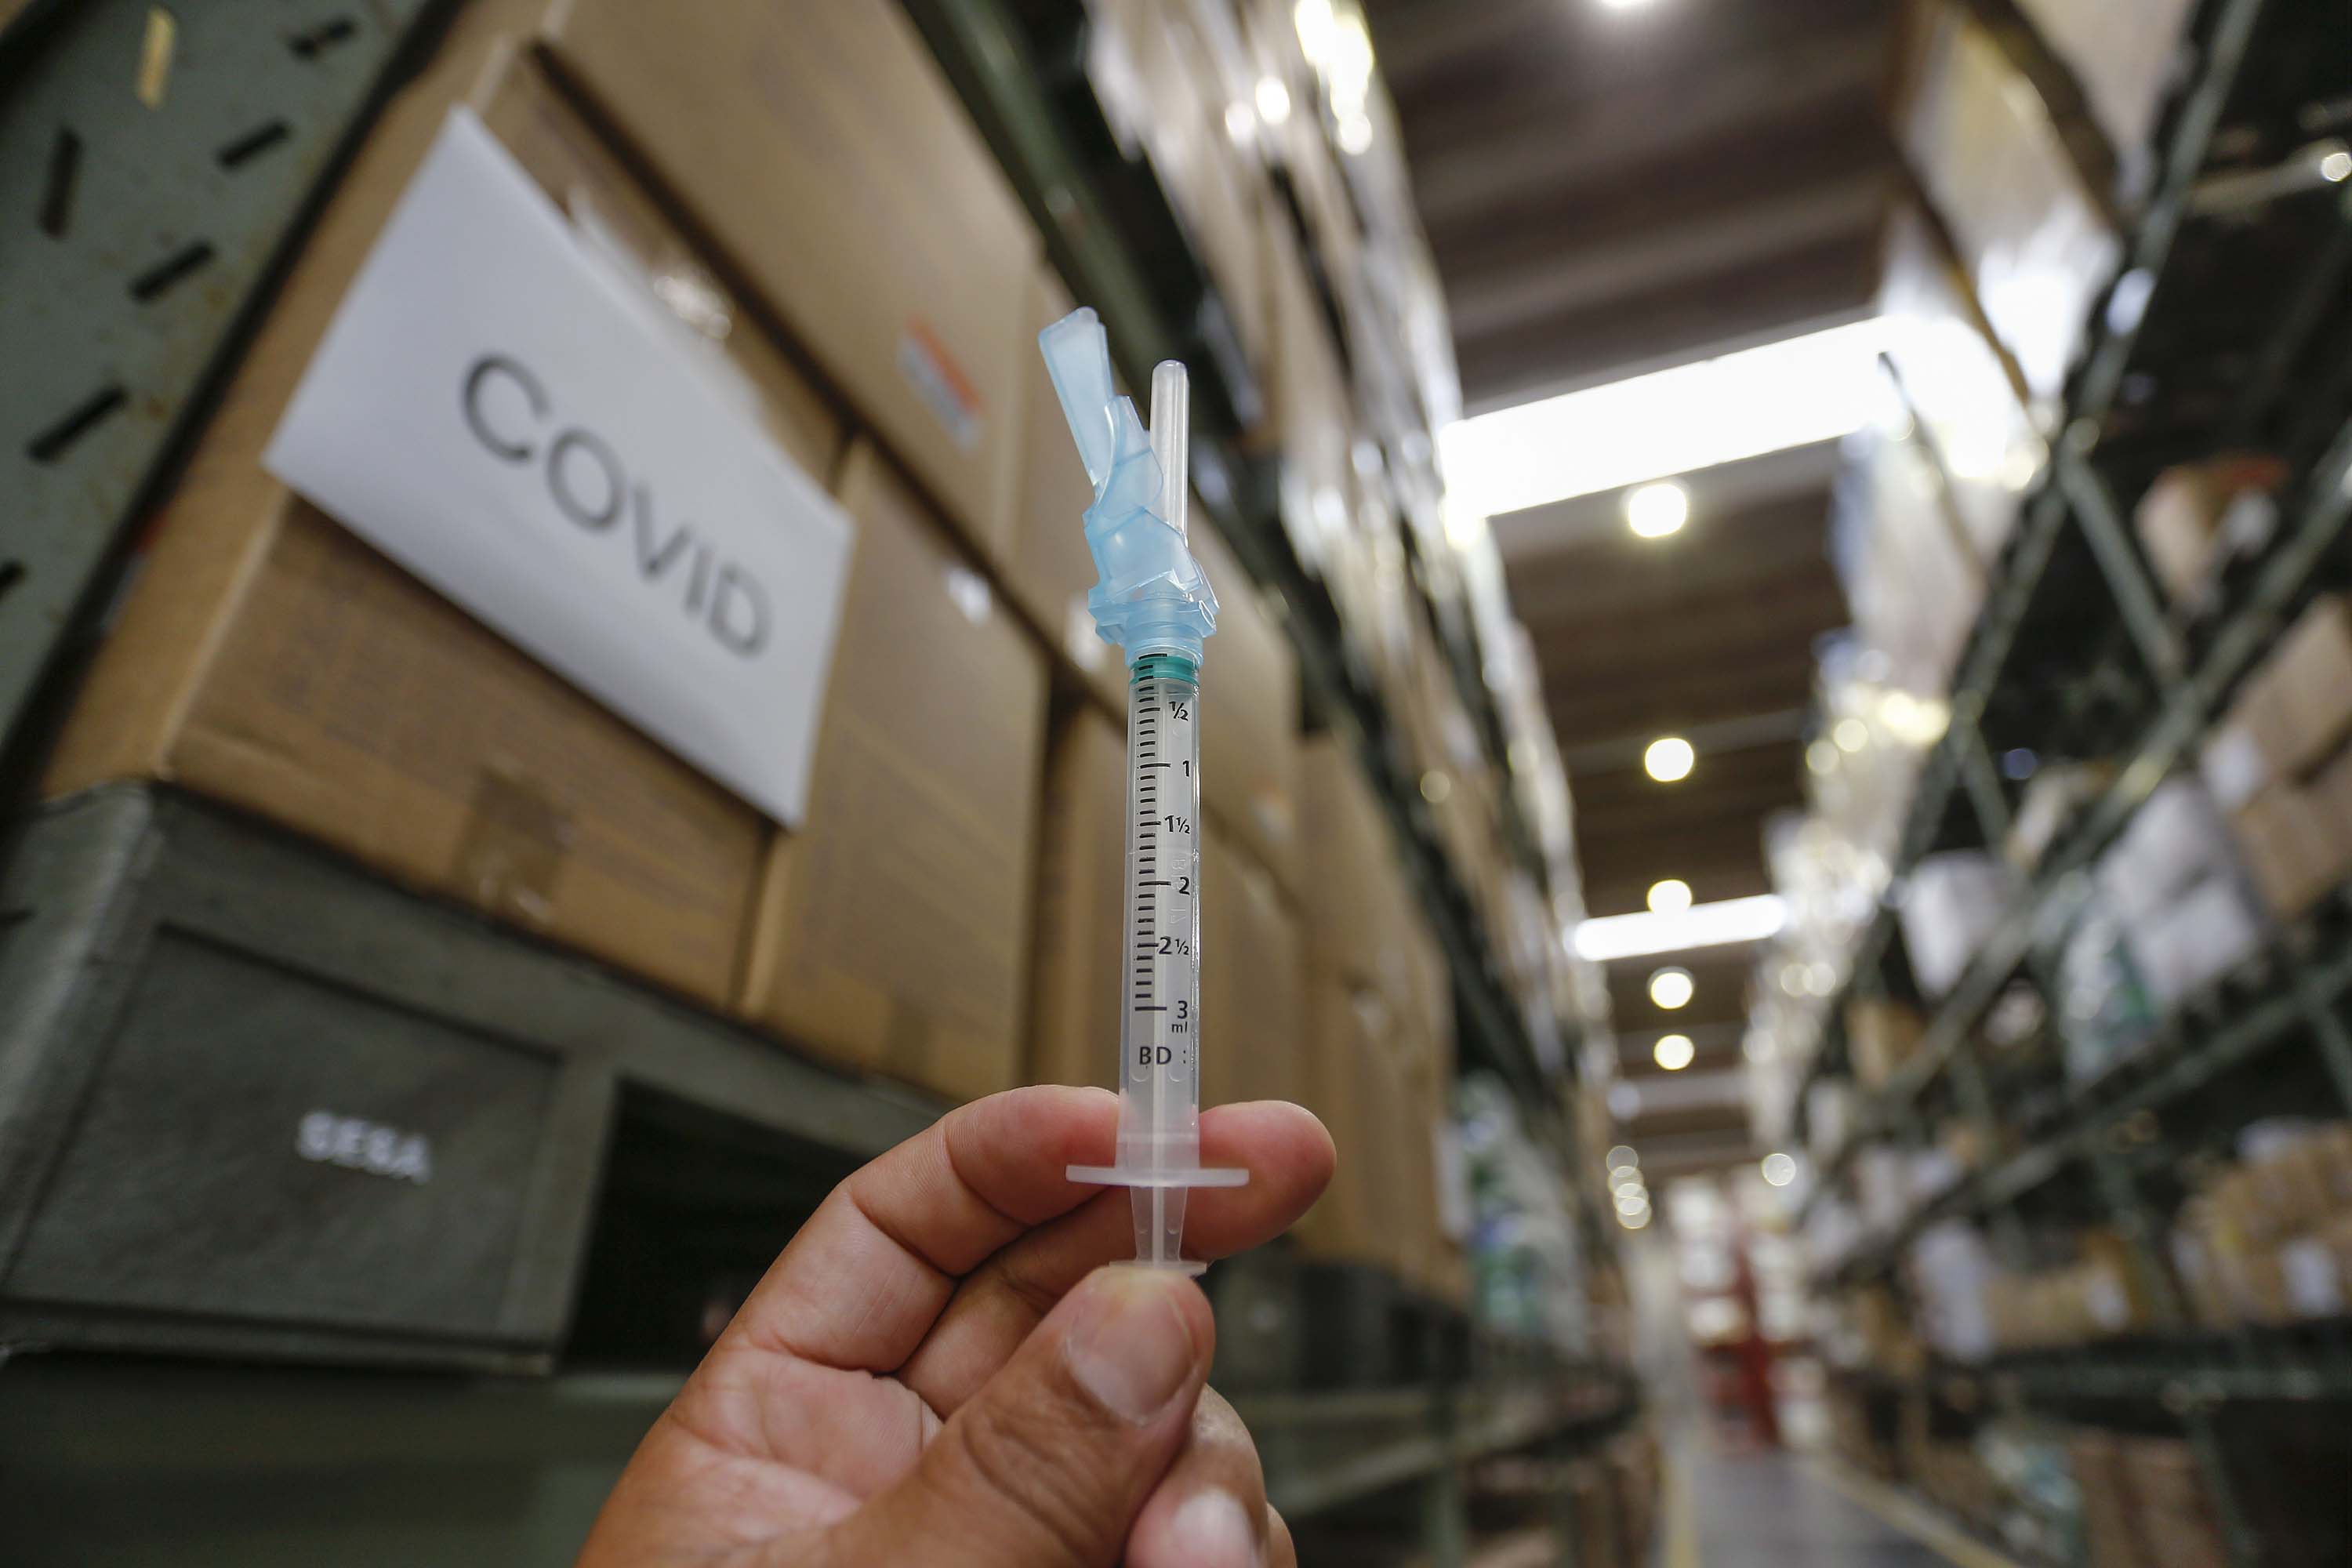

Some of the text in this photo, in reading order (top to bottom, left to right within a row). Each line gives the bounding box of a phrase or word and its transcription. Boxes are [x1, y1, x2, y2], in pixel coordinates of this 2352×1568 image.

[461, 352, 771, 659] COVID
[1182, 760, 1190, 778] 1
[1178, 876, 1190, 895] 2
[1177, 1000, 1189, 1019] 3
[1171, 1022, 1188, 1033] ml
[1139, 1046, 1172, 1065] BD
